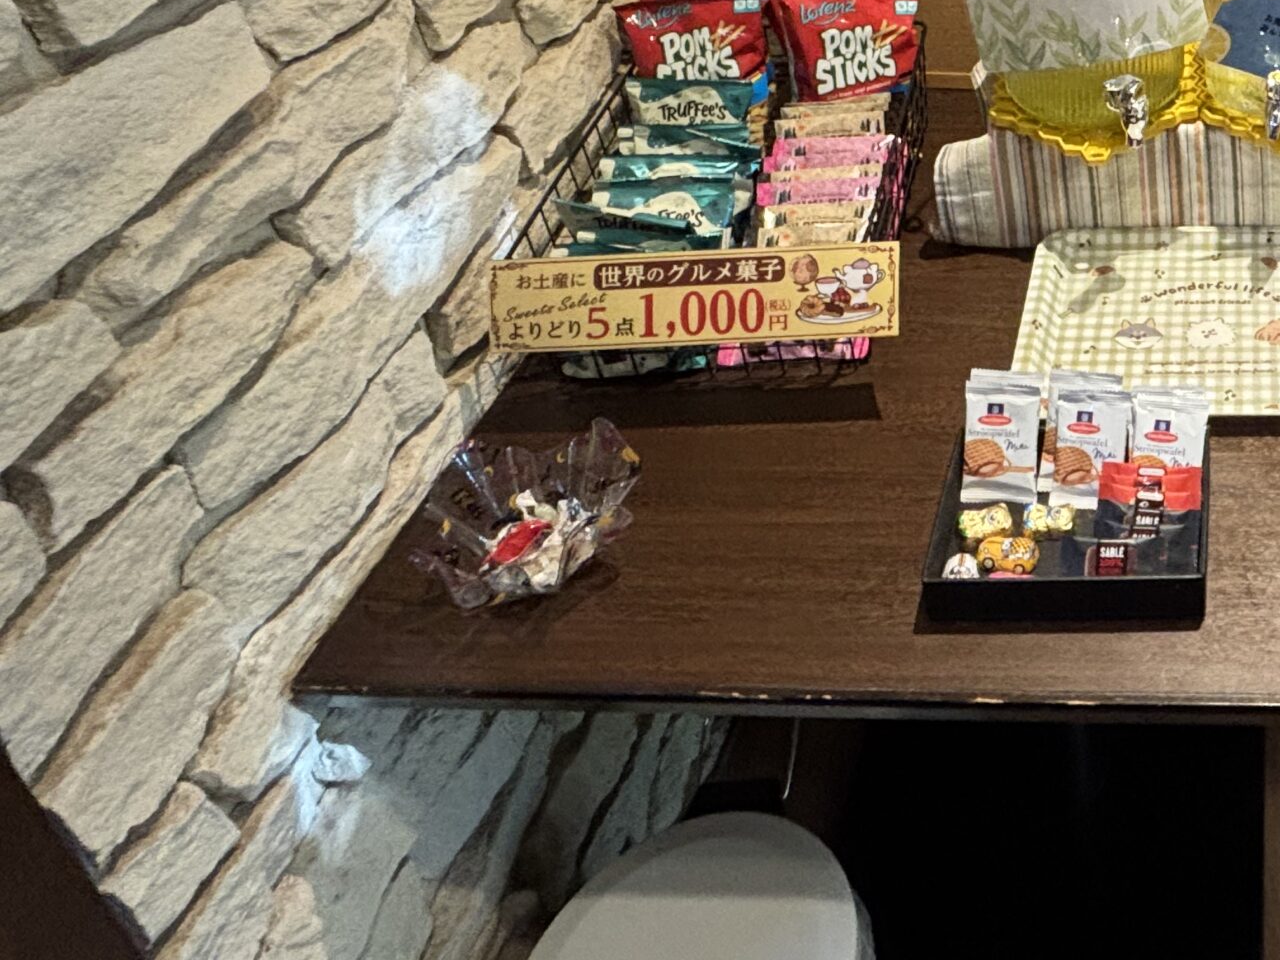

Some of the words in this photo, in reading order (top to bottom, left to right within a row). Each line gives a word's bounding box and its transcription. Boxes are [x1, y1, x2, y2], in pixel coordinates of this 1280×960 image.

[659, 26, 713, 65] POM
[820, 24, 874, 60] POM
[516, 272, 586, 289] お土産に
[599, 258, 782, 288] 世界のグルメ菓子
[1154, 281, 1238, 297] wonderful
[1243, 284, 1271, 297] life
[503, 306, 556, 323] Sweets
[557, 292, 609, 311] Select
